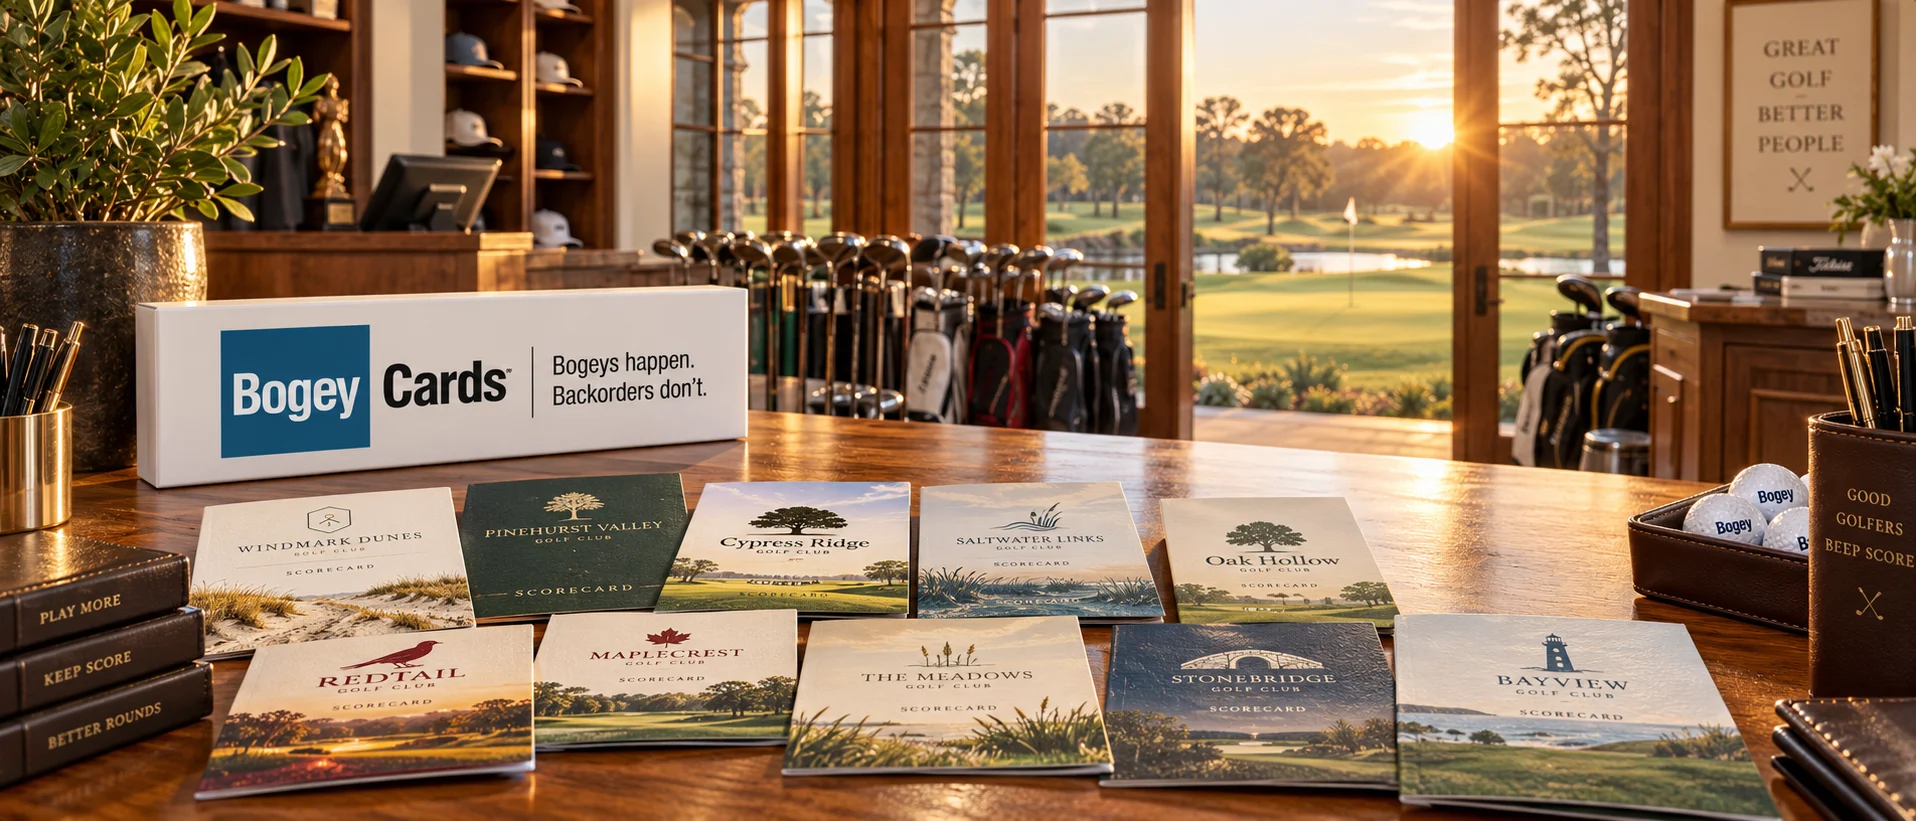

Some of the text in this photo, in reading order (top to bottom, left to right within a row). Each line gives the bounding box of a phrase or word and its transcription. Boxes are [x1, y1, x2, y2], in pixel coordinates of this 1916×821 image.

[1763, 37, 1840, 58] GREAT
[1769, 69, 1833, 89] GOLF
[1758, 104, 1844, 123] BETTER
[1758, 134, 1844, 153] PEOPLE
[553, 351, 695, 378] Bogeys happen.
[233, 372, 361, 423] Bogey
[553, 382, 654, 406] Backorders
[1757, 488, 1794, 504] Bogey
[1847, 487, 1891, 507] GOOD
[484, 520, 663, 538] PINEHURST VALLEY
[1715, 518, 1752, 535] Bogey
[1836, 511, 1903, 536] GOLFERS
[238, 531, 423, 553] WINDMARK DUNES
[720, 537, 870, 550] Cypress Ridge
[956, 535, 1104, 545] SALTWATER LINKS
[1205, 555, 1340, 566] Oak Hollow
[1824, 537, 1861, 557] BEEP
[1865, 546, 1915, 568] SCORE
[286, 564, 375, 576] SCORECARD
[515, 584, 633, 598] SCORECARD
[40, 594, 121, 625] PLAY MORE
[589, 648, 744, 660] MAPLECREST
[44, 651, 132, 687] KEEP SCORE
[317, 667, 466, 688] REDTAIL
[861, 671, 1033, 682] THE MEADOWS
[1171, 674, 1337, 684] STONEBRIDGE
[1497, 675, 1628, 690] BAYVIEW
[337, 682, 436, 694] GOLF CLUB
[1569, 691, 1615, 699] CLUB
[332, 699, 433, 711] SCORECARD
[901, 704, 997, 712] SCORECARD
[1209, 705, 1306, 713] SCORECARD
[1519, 709, 1624, 721] SCORECARD
[47, 702, 162, 750] BETTER ROUNDS
